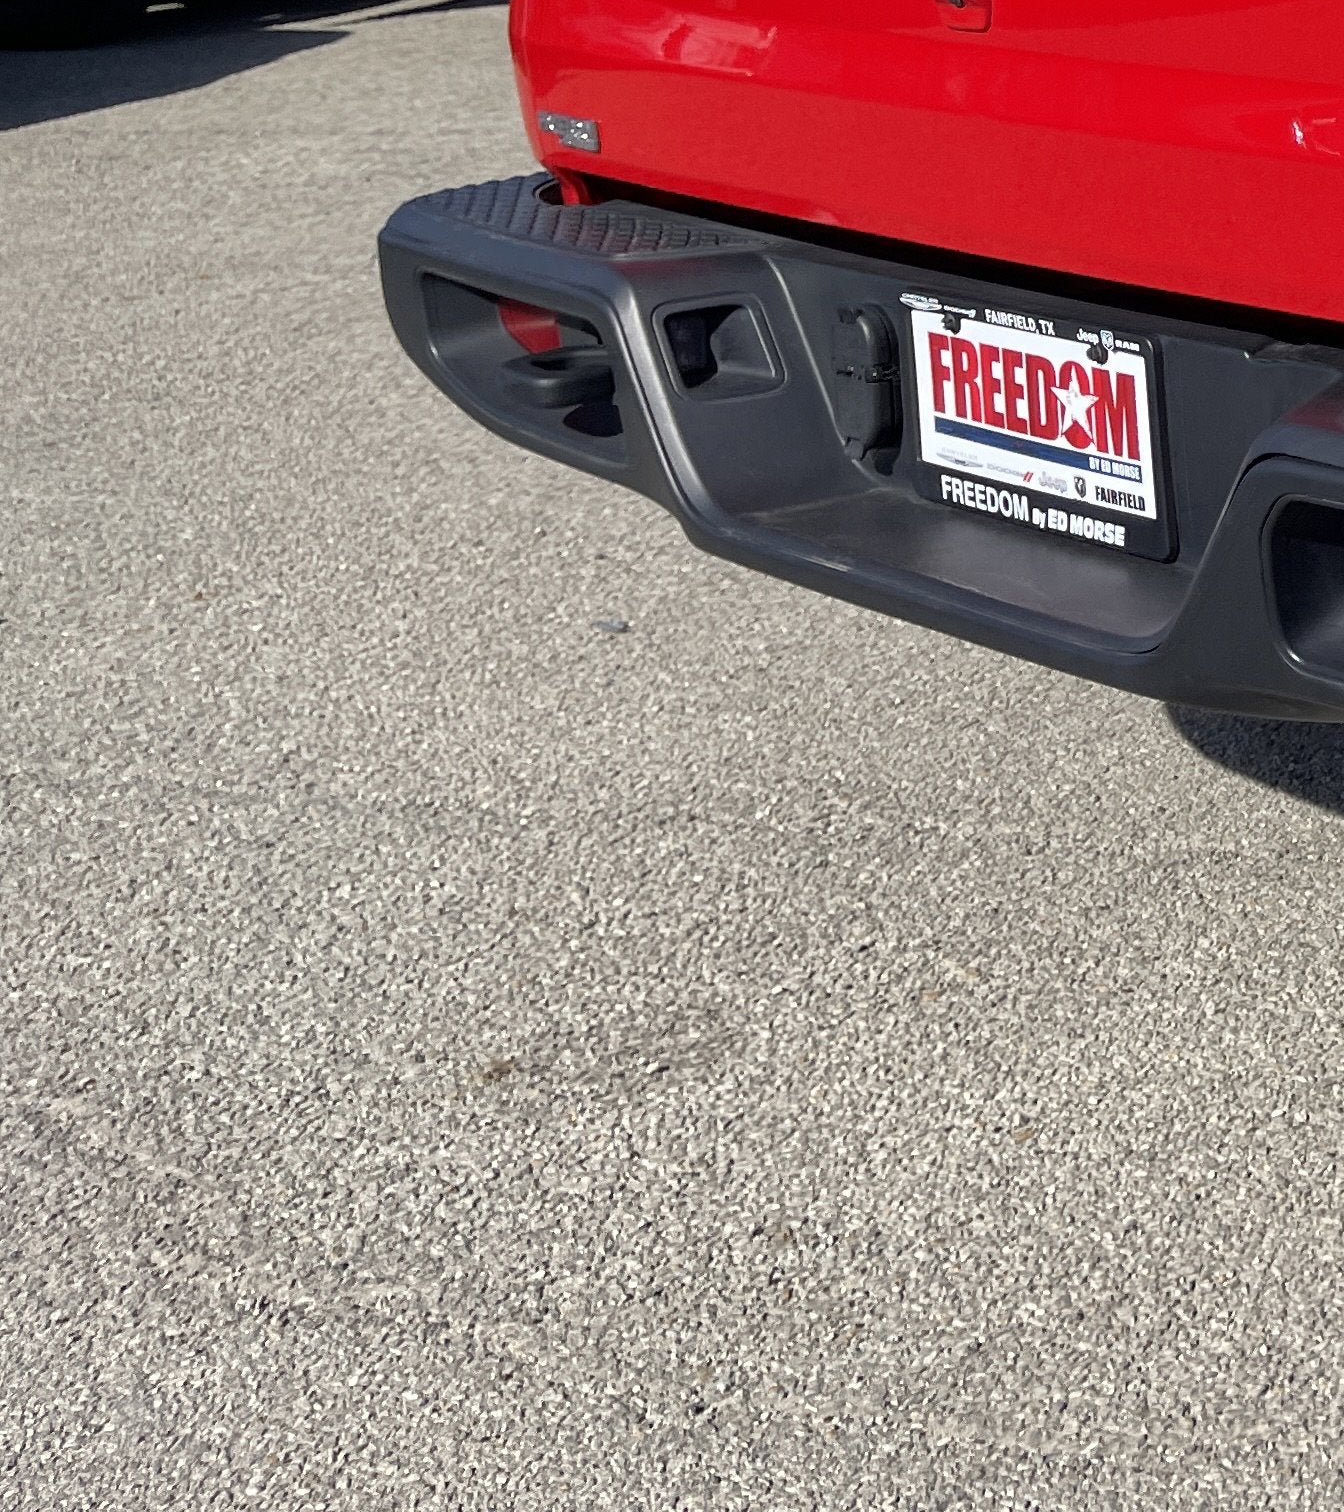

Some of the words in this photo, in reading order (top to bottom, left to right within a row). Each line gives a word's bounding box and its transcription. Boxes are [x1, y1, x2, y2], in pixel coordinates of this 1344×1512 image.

[1038, 319, 1056, 336] TX
[1076, 328, 1100, 346] Jeep
[927, 331, 1142, 461] FREEDOM
[1088, 456, 1100, 471] BY
[1100, 458, 1112, 474] ED
[1111, 461, 1142, 481] MORSE
[940, 474, 1030, 523] FREEDOM
[1047, 508, 1068, 533] ED
[1069, 513, 1126, 548] MORSE
[1094, 484, 1146, 512] FAIRFIELD
